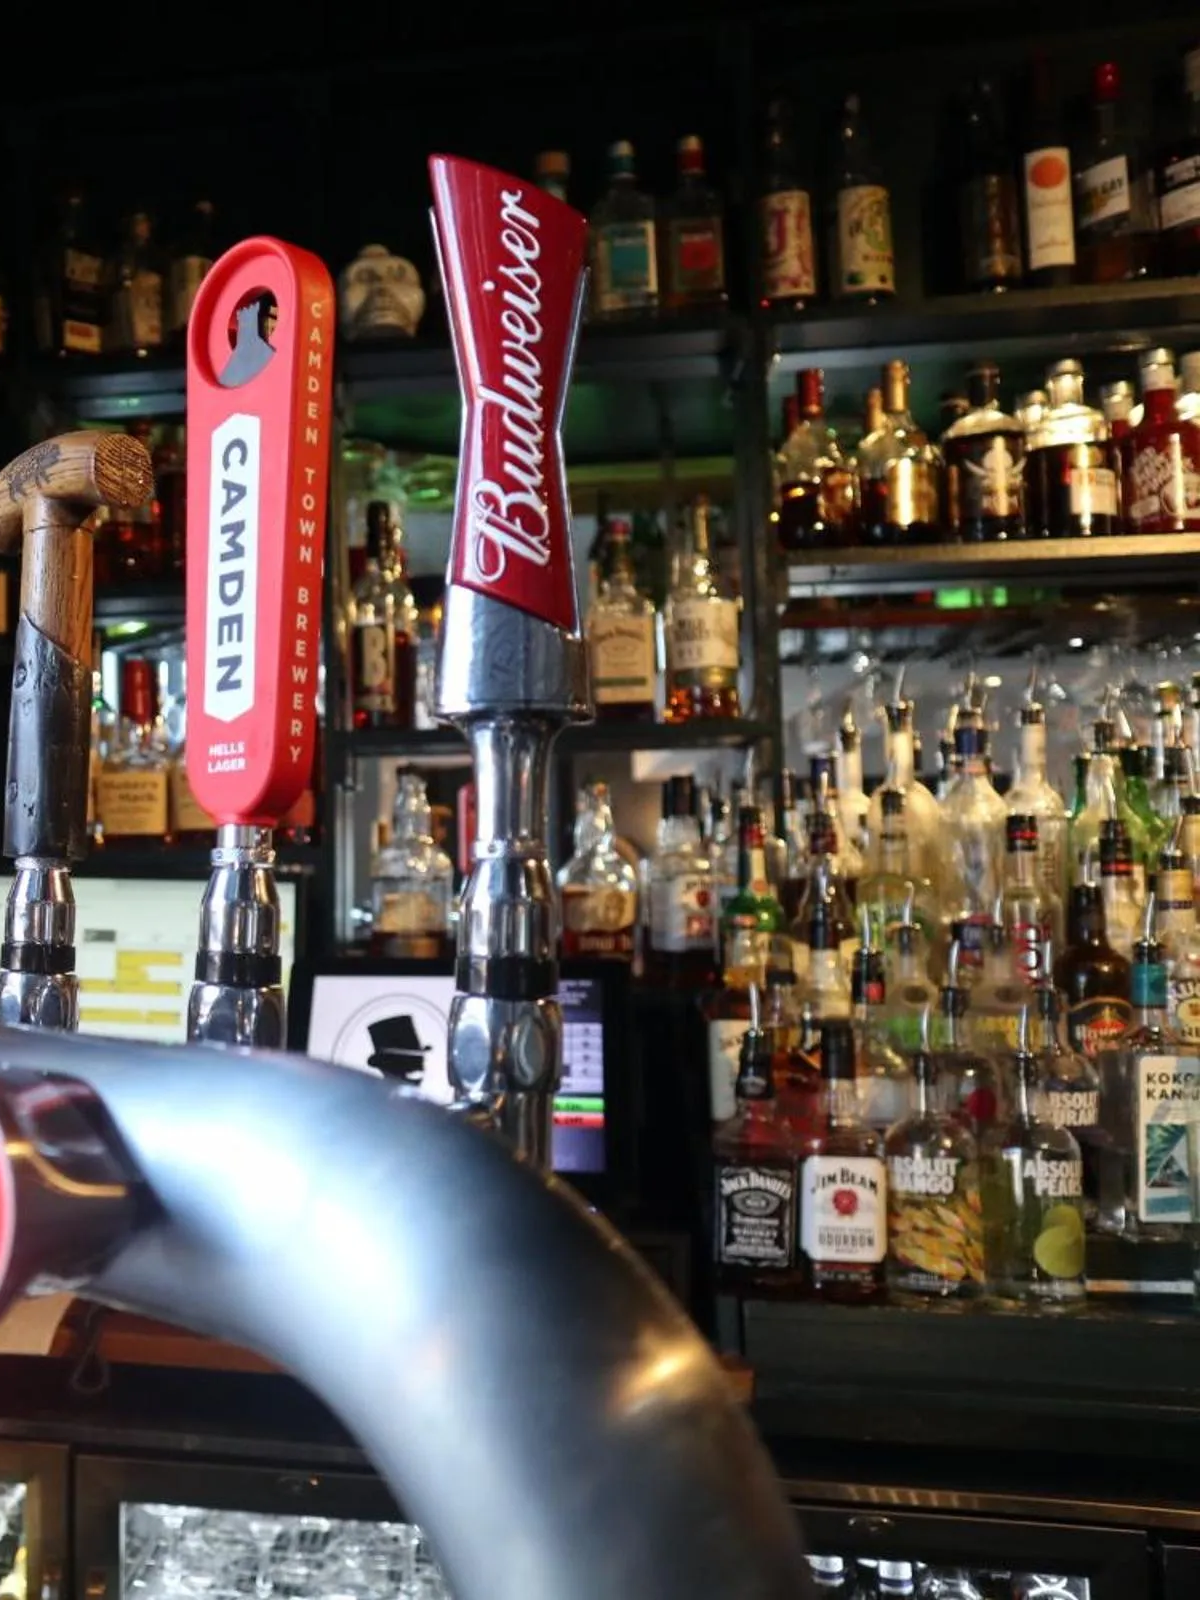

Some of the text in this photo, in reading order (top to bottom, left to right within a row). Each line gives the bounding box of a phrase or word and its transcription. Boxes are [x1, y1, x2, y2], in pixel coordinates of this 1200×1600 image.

[474, 189, 550, 583] Budweiser
[289, 301, 323, 765] CAMDEN TOWN BREWERY
[215, 438, 249, 693] CAMDEN
[208, 741, 245, 757] HELLS
[207, 758, 247, 774] LAGER
[810, 1166, 879, 1195] JIM BEAM
[818, 1232, 875, 1247] BOURBON
